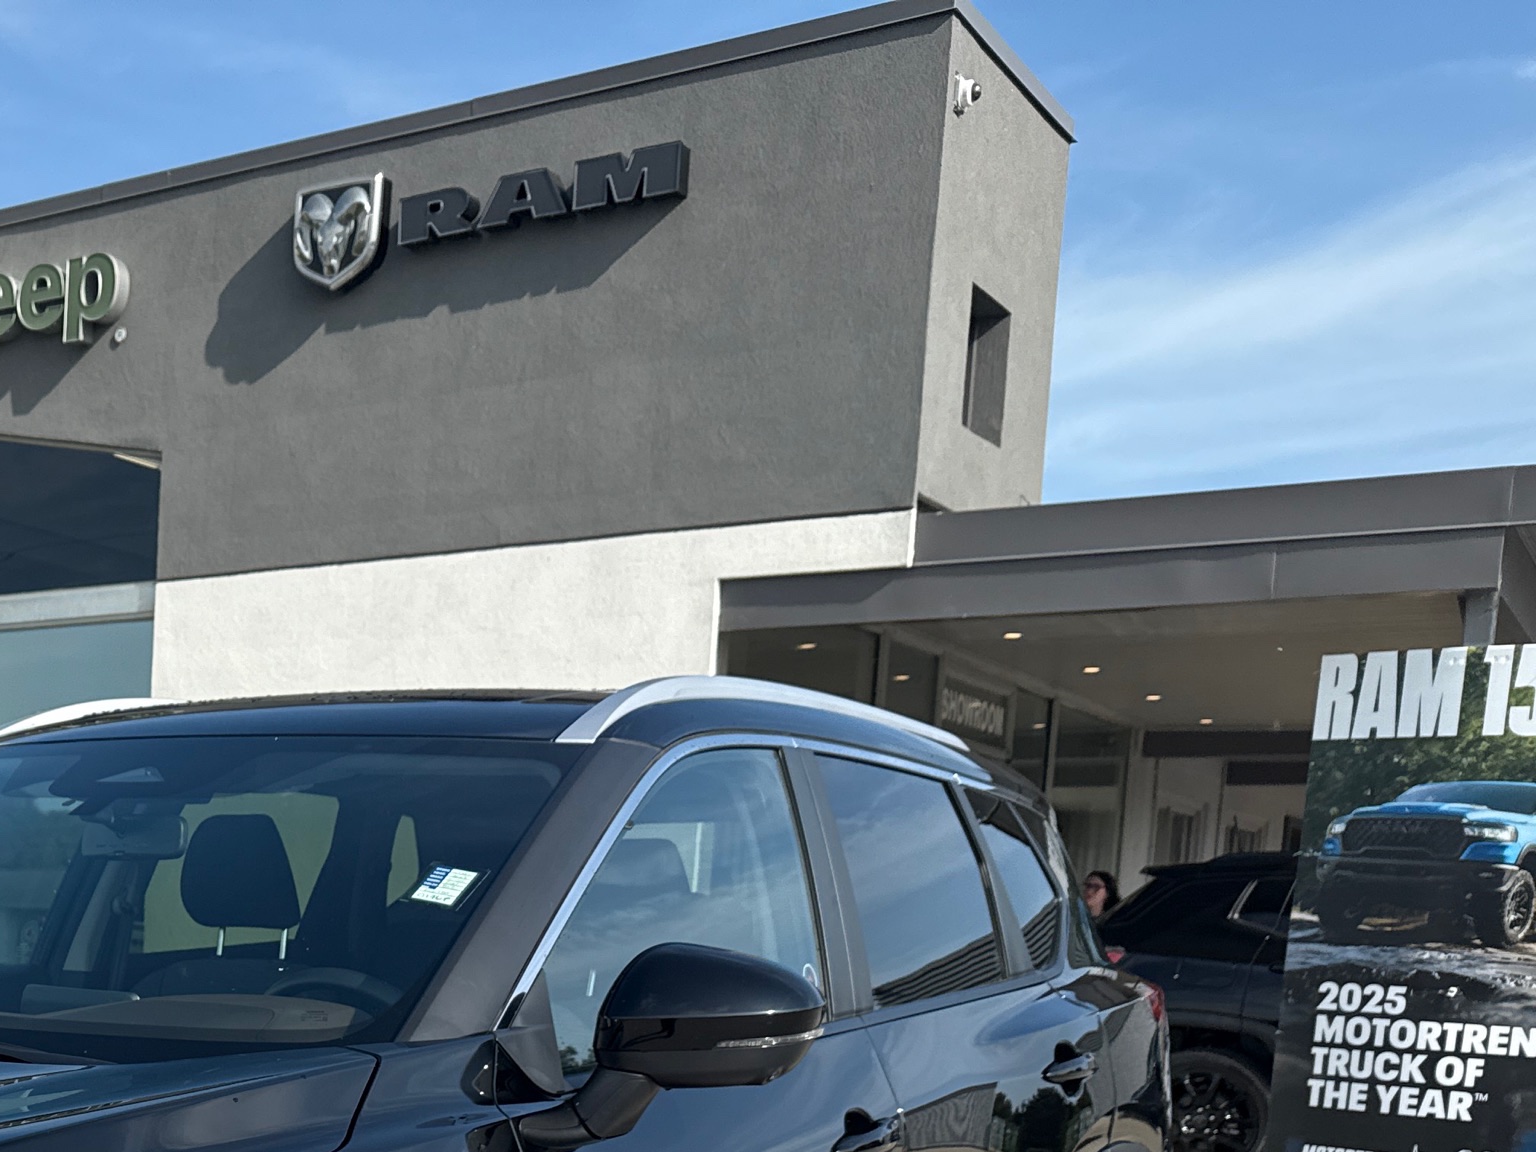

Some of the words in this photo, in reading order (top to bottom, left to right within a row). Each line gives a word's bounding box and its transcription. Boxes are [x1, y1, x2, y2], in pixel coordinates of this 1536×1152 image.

[397, 140, 690, 247] RAM
[941, 686, 1005, 737] SHOWROOM
[1312, 646, 1469, 741] RAM
[1316, 980, 1408, 1015] 2025
[1311, 1046, 1429, 1084] TRUCK
[1435, 1055, 1486, 1088] OF
[1307, 1078, 1369, 1112] THE
